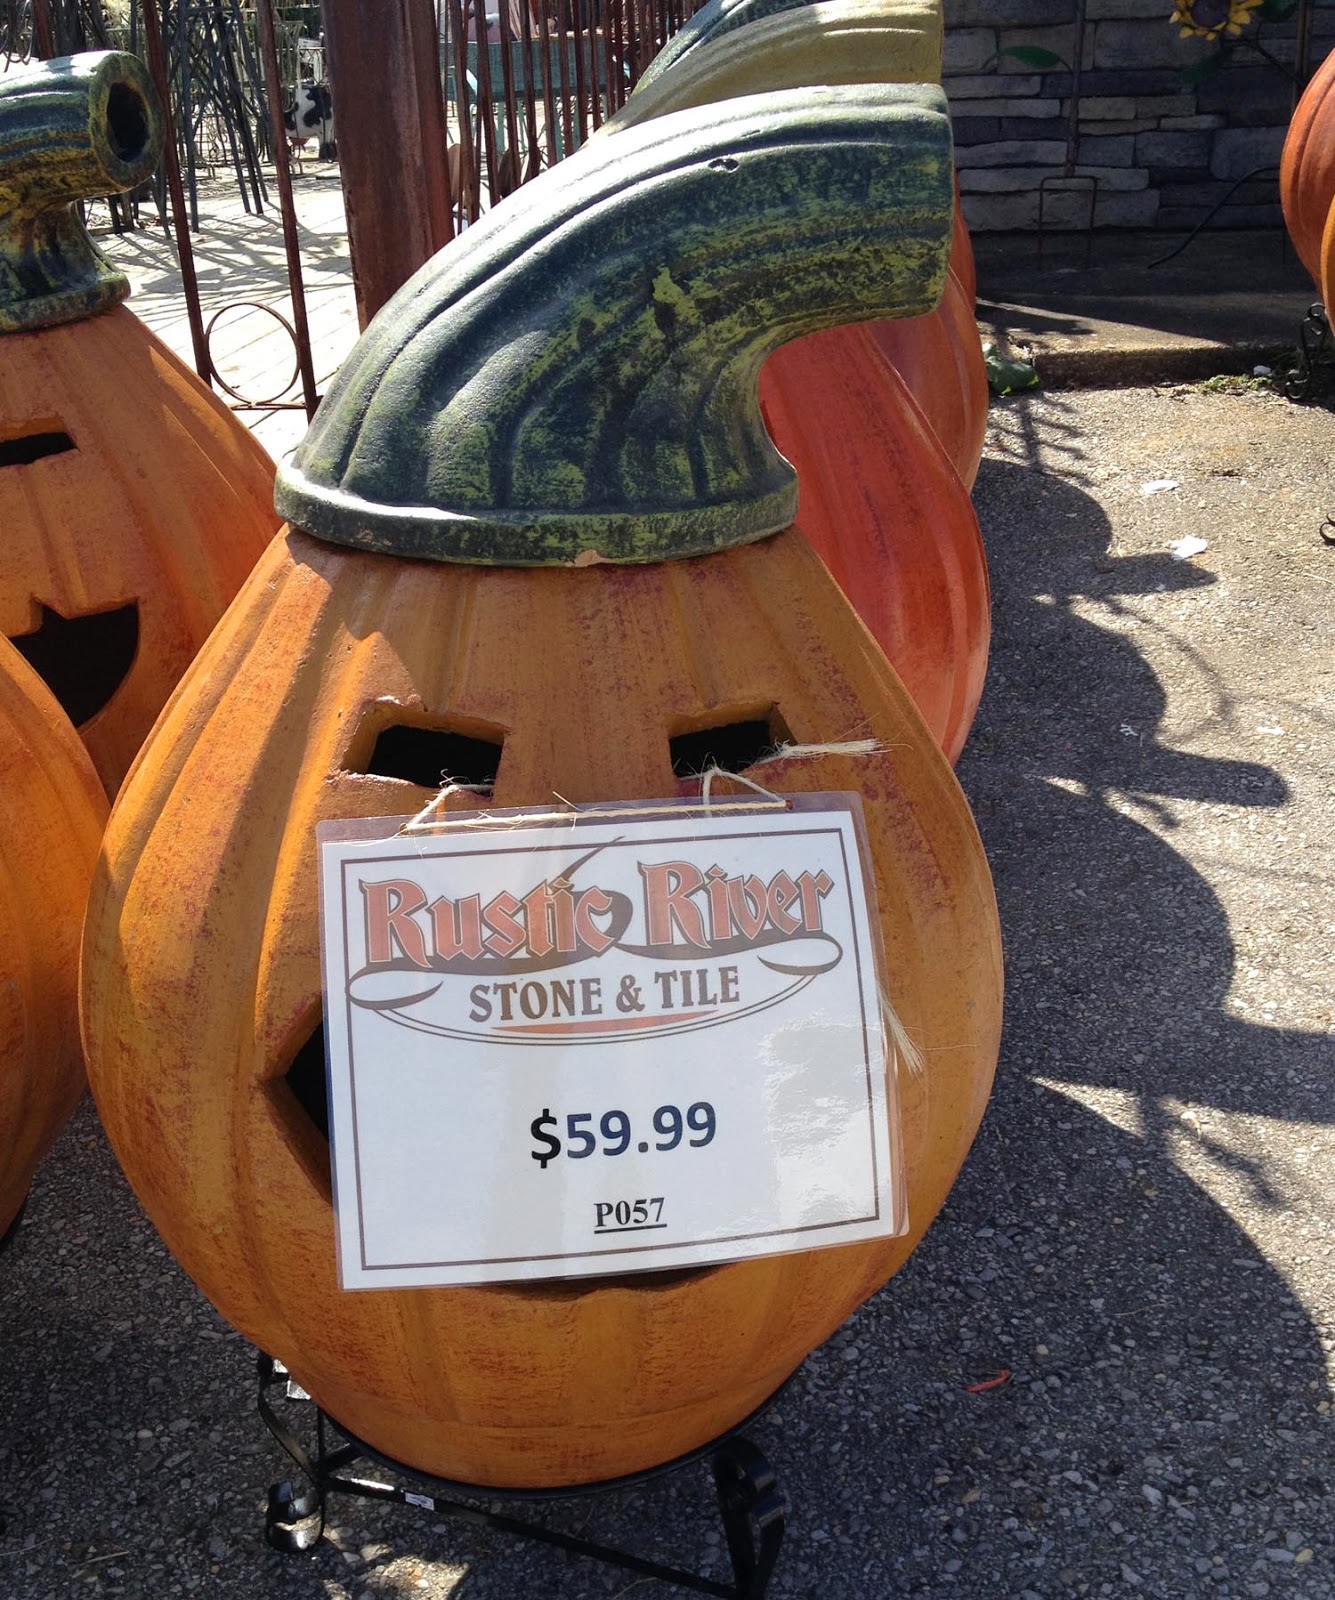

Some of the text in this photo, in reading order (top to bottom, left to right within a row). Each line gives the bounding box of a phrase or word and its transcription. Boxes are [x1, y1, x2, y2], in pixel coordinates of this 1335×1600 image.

[358, 860, 834, 969] Rustic River
[469, 965, 740, 1023] STONE & TILE
[530, 1101, 718, 1169] $59.99
[594, 1197, 666, 1228] P057
